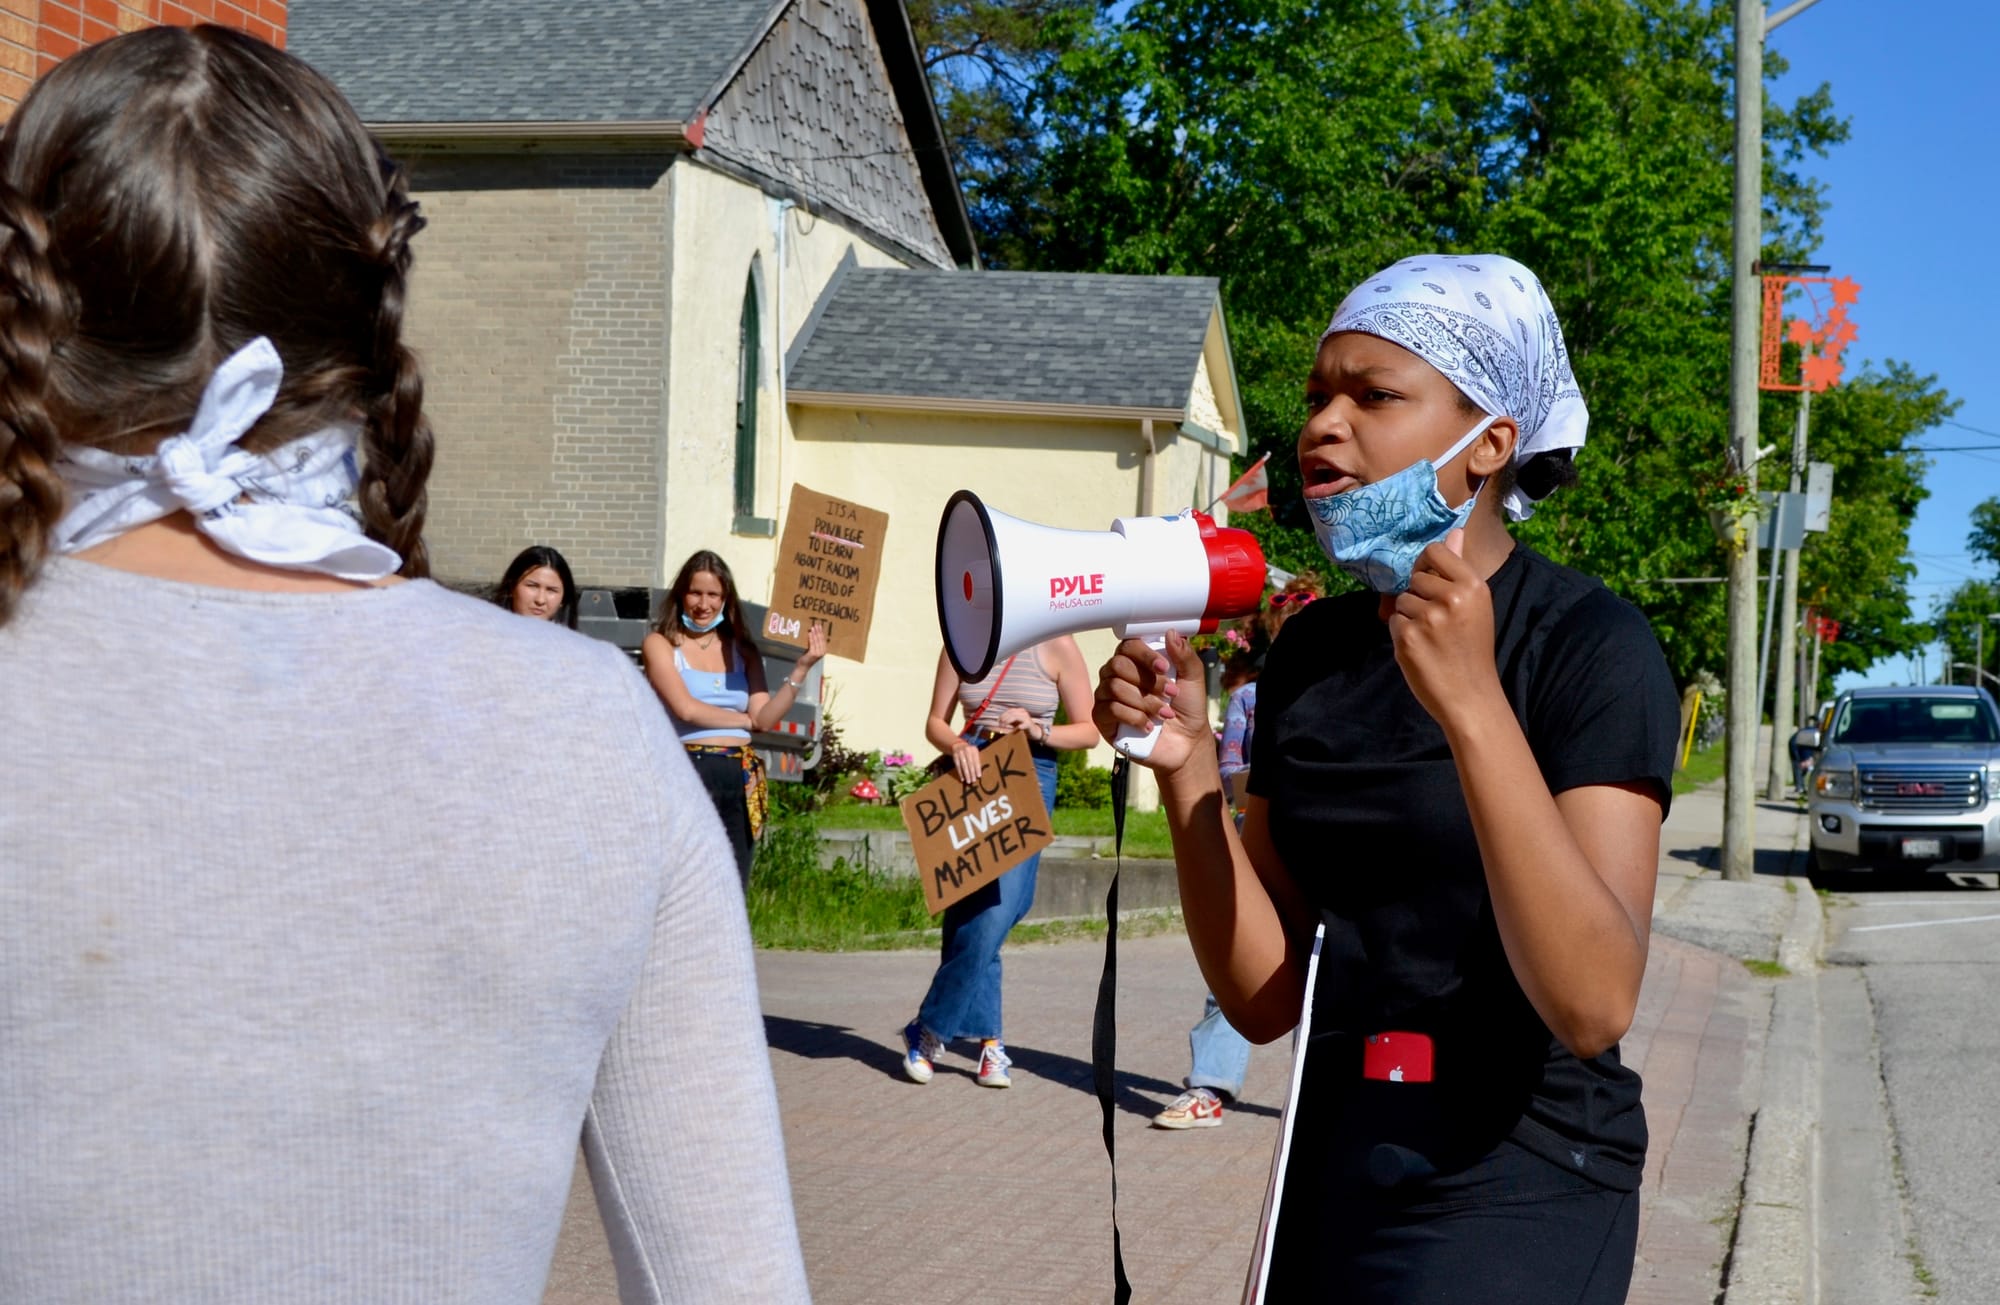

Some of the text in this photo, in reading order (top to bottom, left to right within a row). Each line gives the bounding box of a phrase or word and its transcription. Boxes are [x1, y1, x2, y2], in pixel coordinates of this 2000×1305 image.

[826, 500, 857, 522] ITS A
[814, 517, 864, 543] PRIVILEGE
[808, 536, 854, 560] TO LEARN
[793, 552, 860, 582] ABOUT RACISM
[799, 573, 855, 597] INSTEAD OF
[1050, 574, 1104, 598] PYLE
[793, 594, 860, 623] EXPERIENCING
[1049, 598, 1103, 611] PyleUSA.com
[768, 612, 800, 639] BLM
[915, 749, 1026, 837] BLACK
[948, 795, 1013, 849] LIVES
[934, 816, 1046, 899] MATTER
